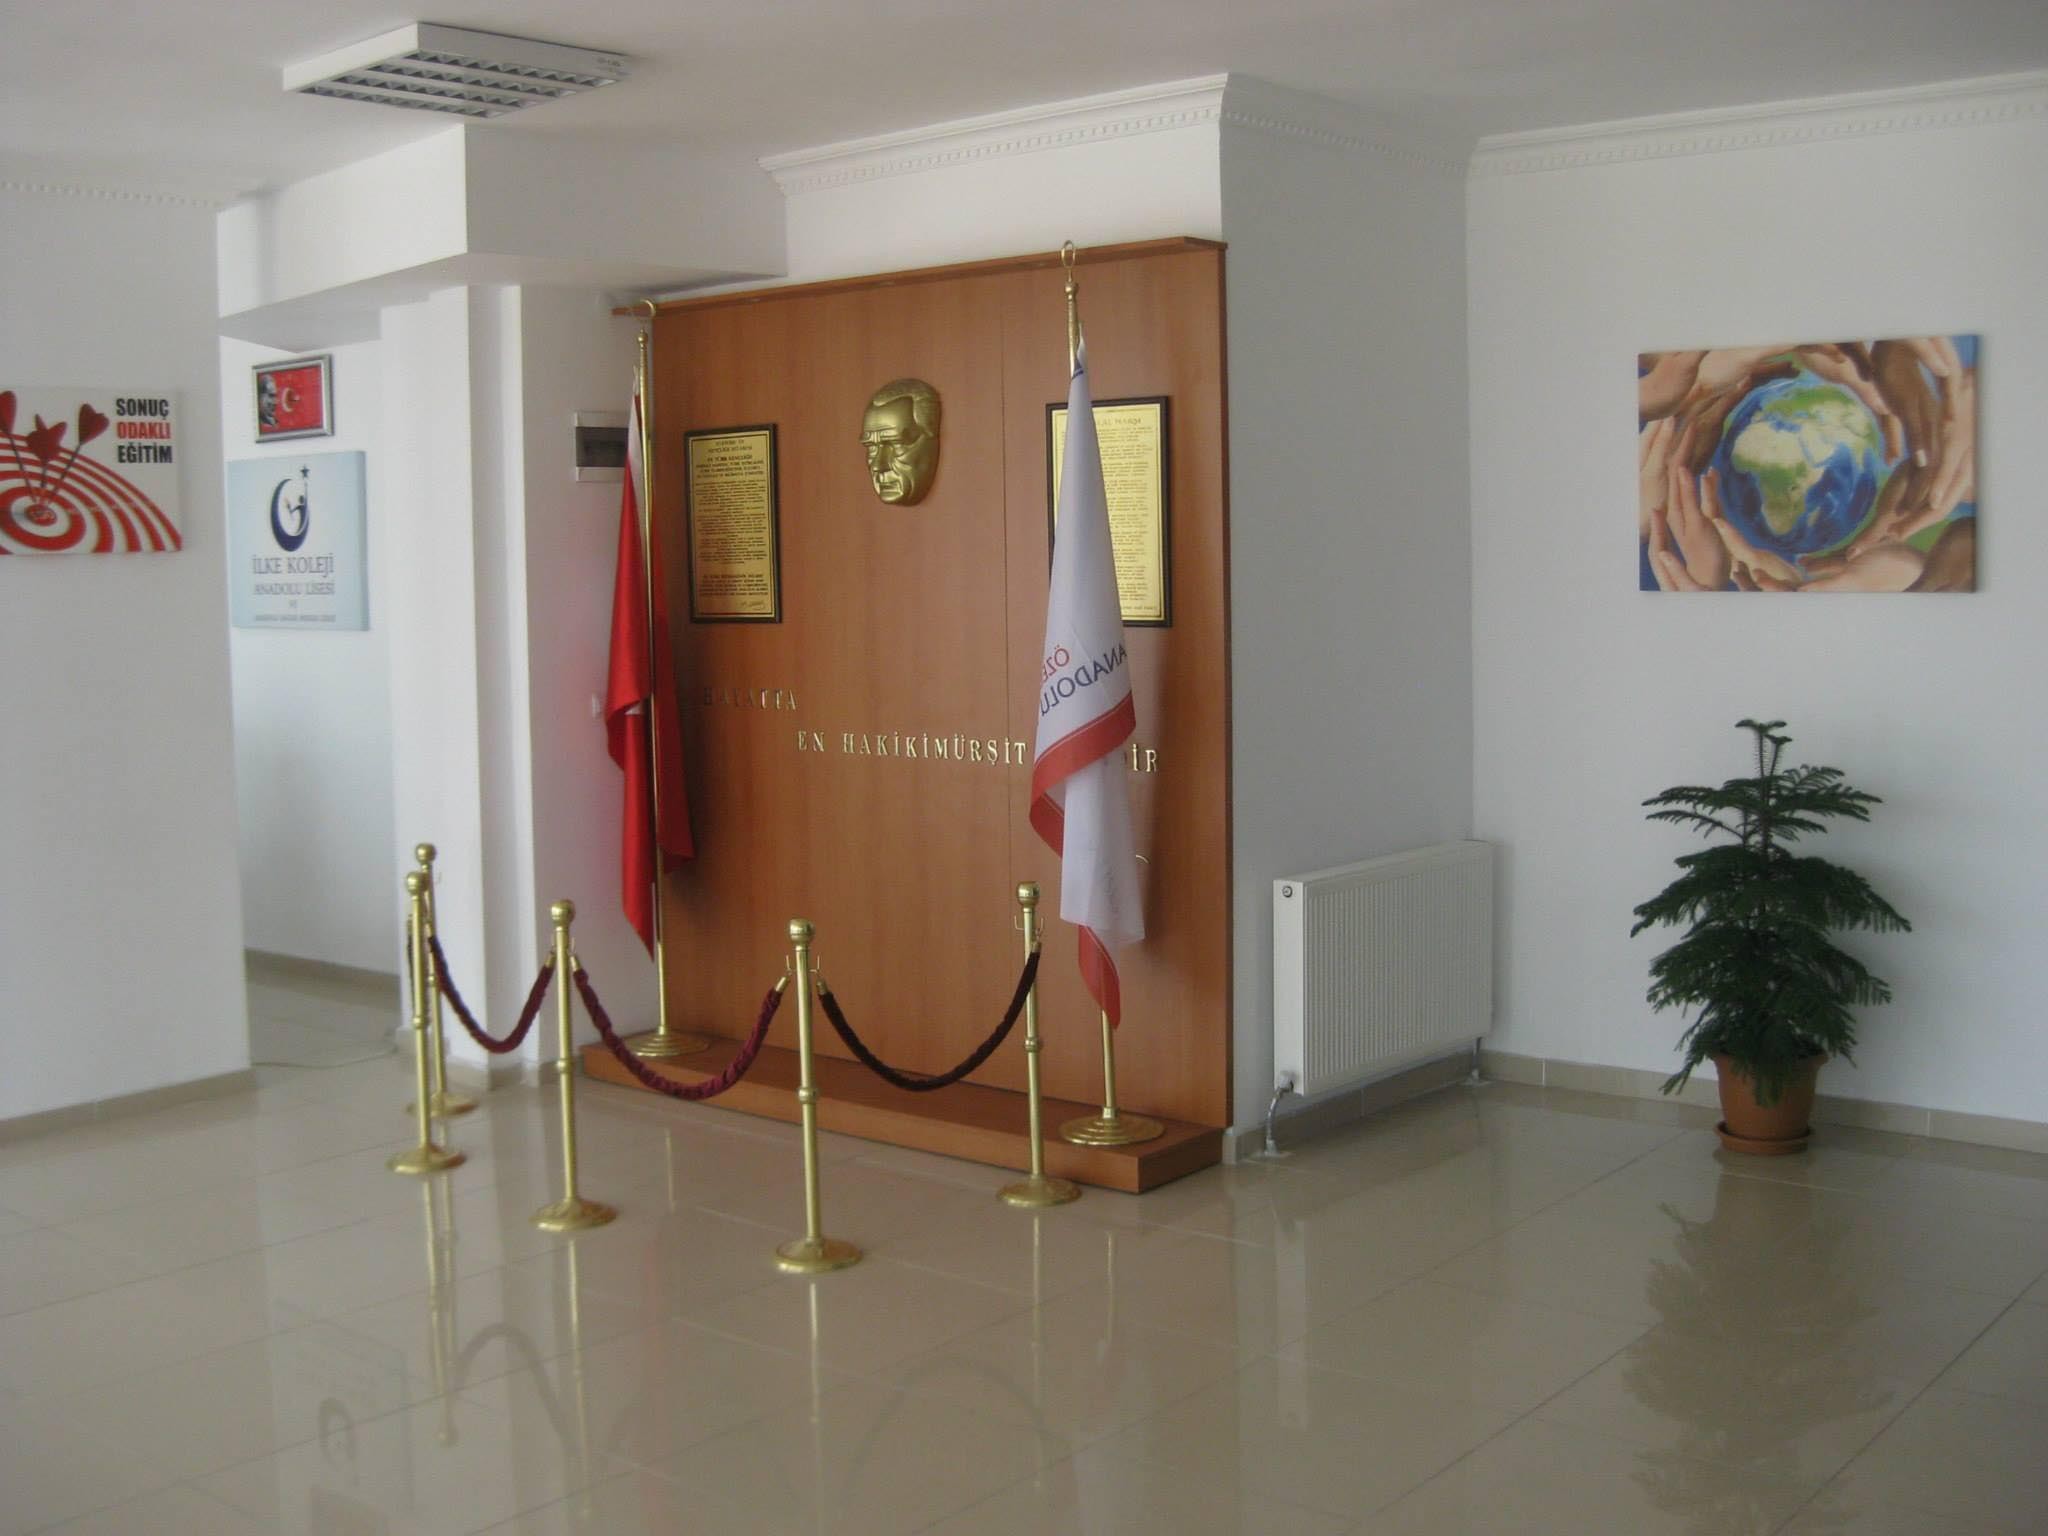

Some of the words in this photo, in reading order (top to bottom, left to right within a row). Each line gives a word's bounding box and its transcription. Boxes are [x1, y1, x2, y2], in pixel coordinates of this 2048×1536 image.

[115, 397, 170, 418] SONUÇ
[116, 421, 171, 440] ODAKLI
[117, 442, 173, 464] EĞİTİM
[252, 554, 283, 574] İLKE
[286, 552, 335, 578] KOLEJİ
[797, 730, 825, 752] EN
